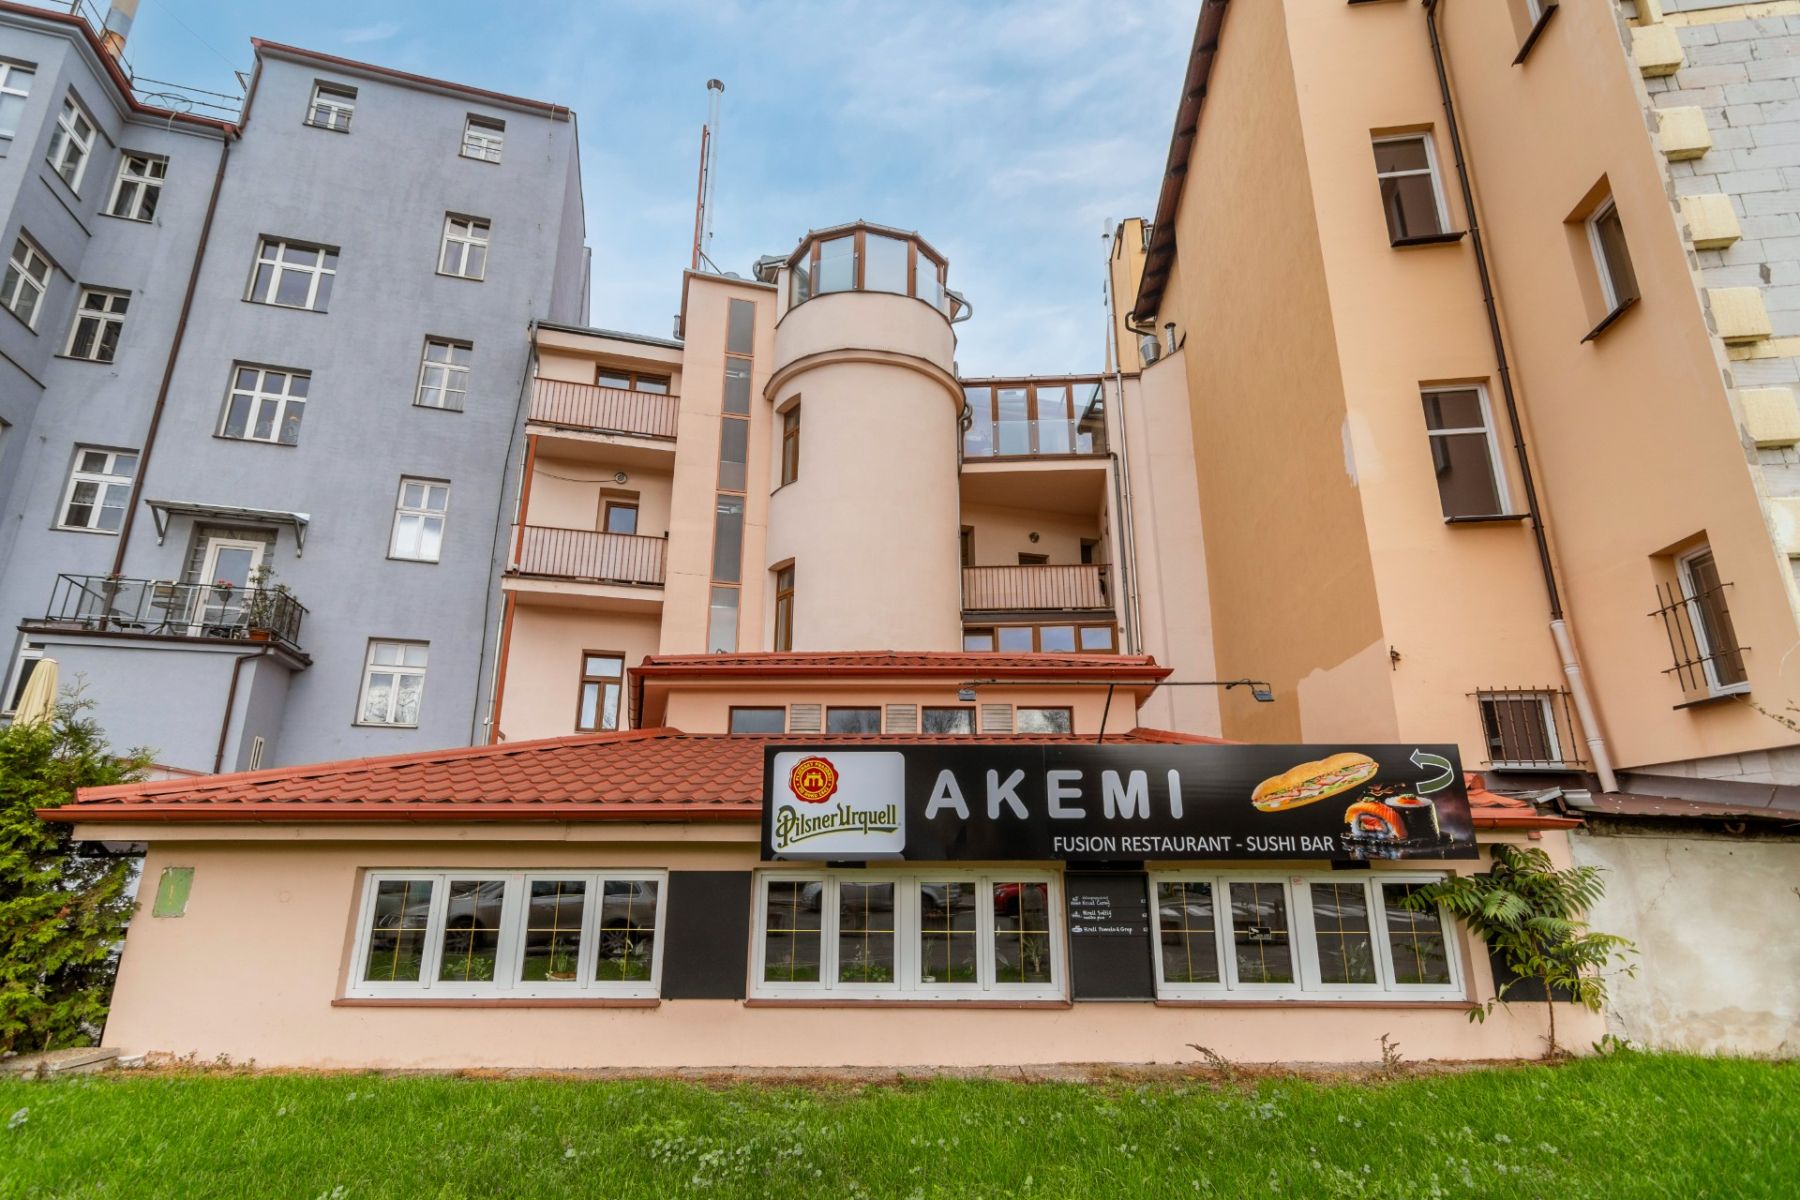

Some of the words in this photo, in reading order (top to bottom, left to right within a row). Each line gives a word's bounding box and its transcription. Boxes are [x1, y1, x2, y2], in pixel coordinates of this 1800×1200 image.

[924, 768, 1184, 820] AKEMI
[775, 804, 838, 849] Pilsner
[836, 802, 896, 835] Urquell
[1054, 836, 1116, 852] FUSION
[1121, 836, 1231, 852] RESTAURANT
[1246, 836, 1296, 852] SUSHI
[1300, 836, 1335, 852] BAR
